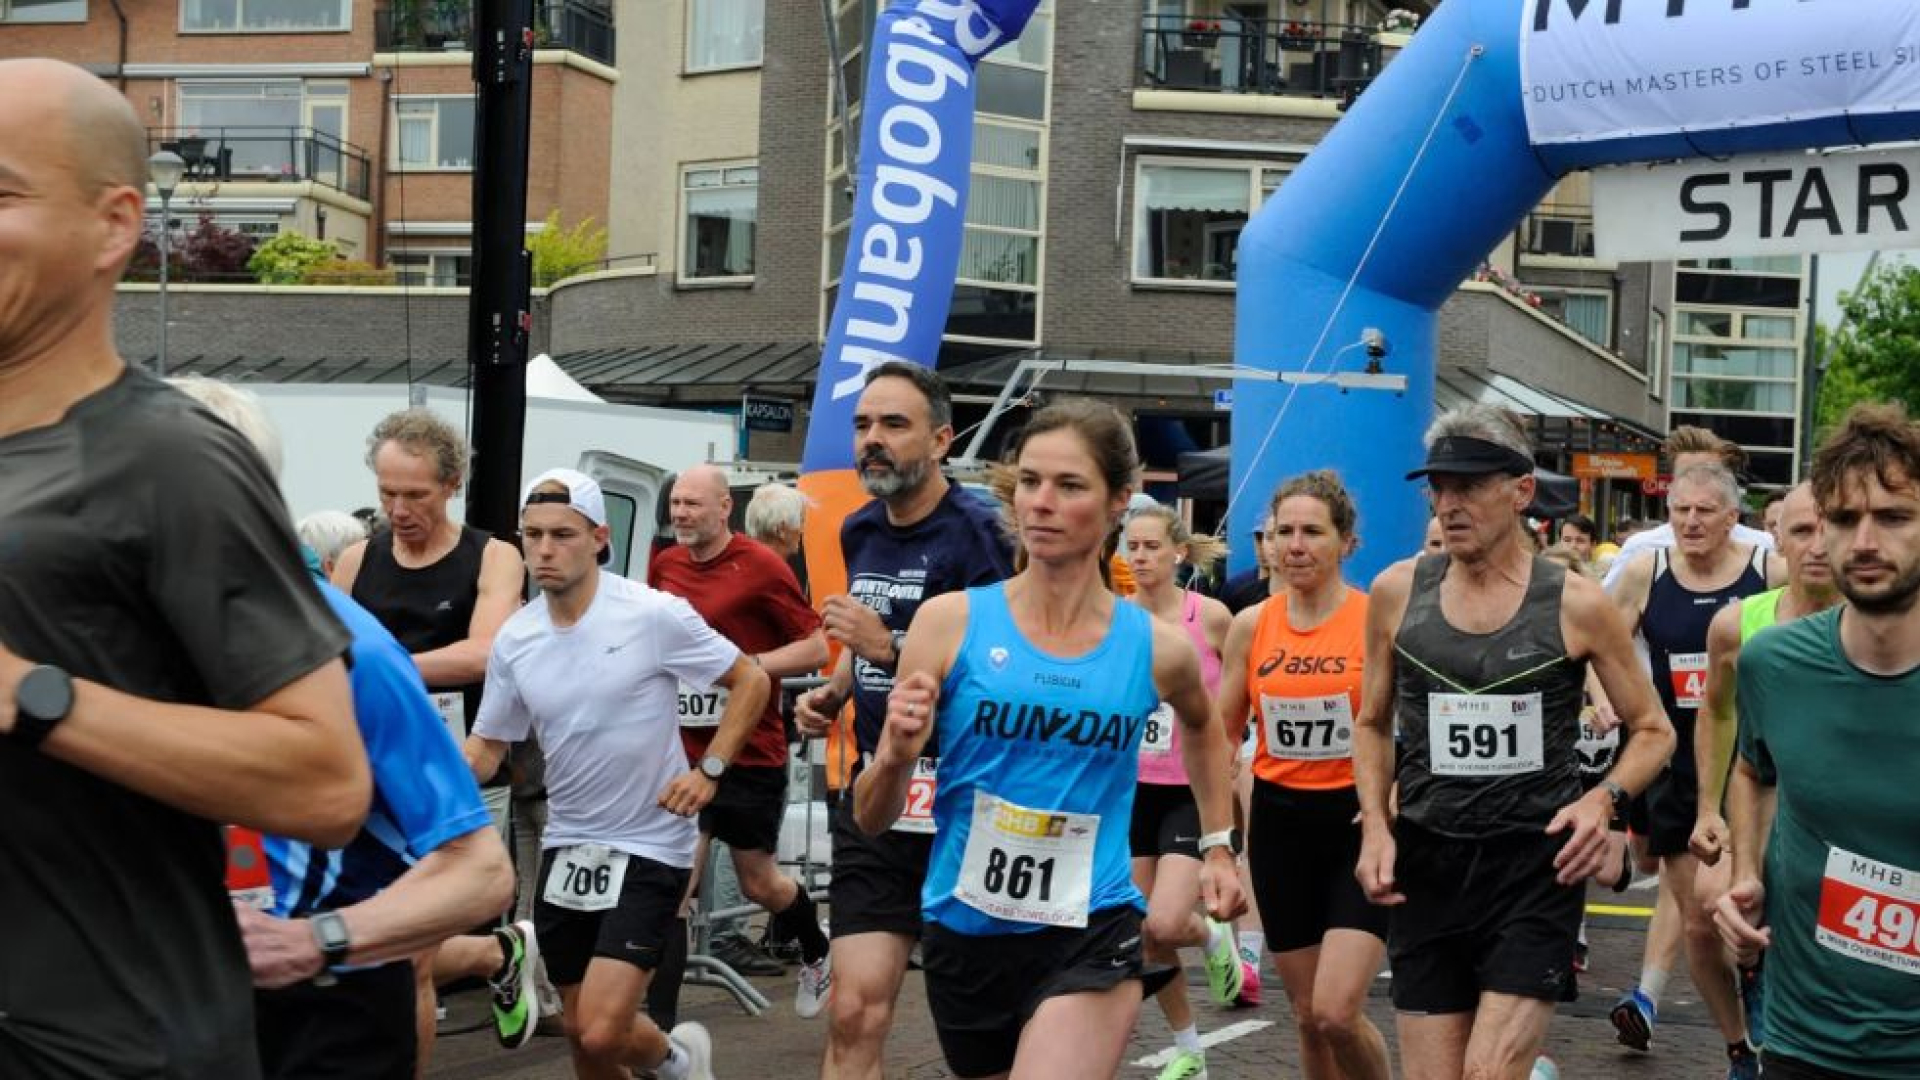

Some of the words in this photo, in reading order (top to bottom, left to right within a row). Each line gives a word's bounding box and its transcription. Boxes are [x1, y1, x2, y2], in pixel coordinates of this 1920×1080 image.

[1533, 79, 1616, 103] DUTCH
[1626, 65, 1743, 95] MASTERS
[1754, 60, 1789, 82] OF
[1800, 50, 1880, 76] STEEL
[1893, 45, 1920, 66] SI
[1679, 162, 1911, 242] STAR
[1284, 656, 1347, 675] asics
[679, 693, 719, 716] 507
[1276, 719, 1335, 748] 677
[1448, 723, 1518, 760] 591
[562, 860, 612, 897] 706
[983, 846, 1056, 902] 861
[1850, 858, 1903, 887] MHB
[1843, 896, 1920, 953] 49
